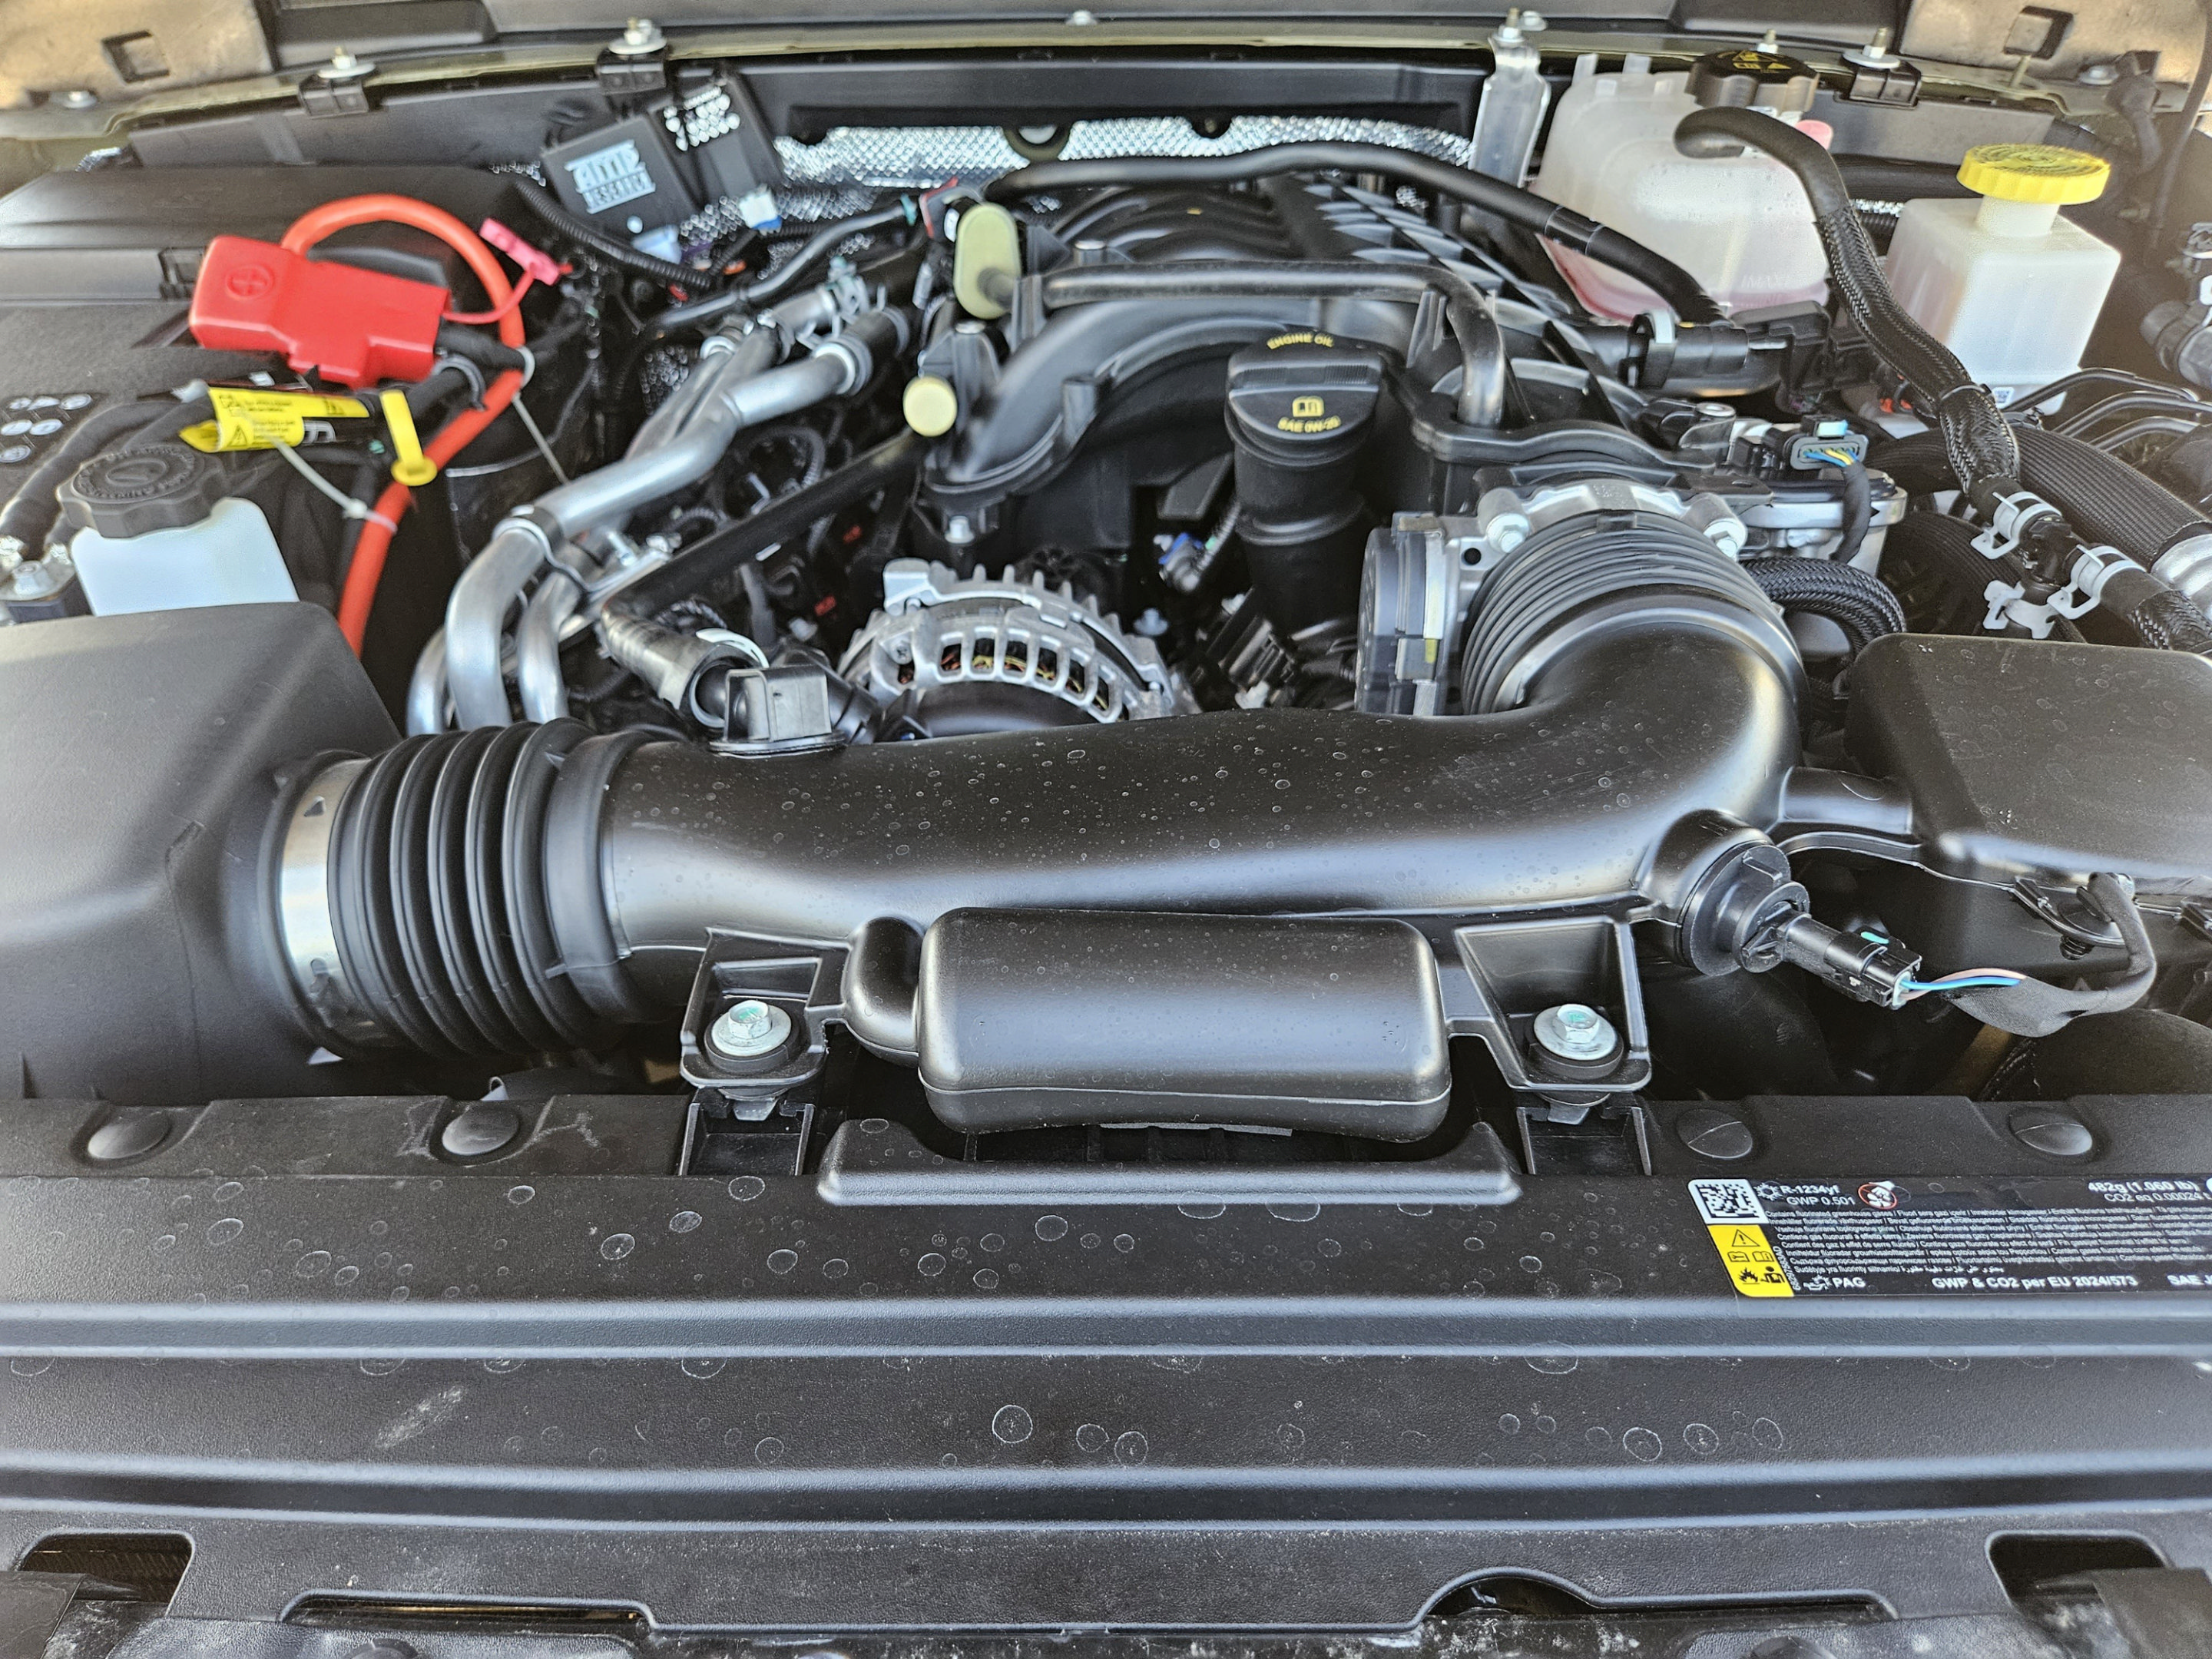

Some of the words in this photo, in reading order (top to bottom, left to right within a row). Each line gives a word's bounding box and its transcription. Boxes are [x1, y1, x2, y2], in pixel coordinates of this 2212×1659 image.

[1267, 332, 1313, 349] ENGINE
[1314, 333, 1335, 348] OIL
[1277, 416, 1304, 433] SAE
[1304, 415, 1341, 433] 0W-20
[1780, 1184, 1840, 1195] R-1234yf
[2088, 1181, 2128, 1194] 482g
[2126, 1181, 2175, 1192] (1.060
[2174, 1181, 2200, 1191] lb)
[1786, 1196, 1819, 1205] GWP
[1822, 1196, 1856, 1205] 0.501
[2104, 1193, 2134, 1202] CO2
[2135, 1194, 2155, 1203] eq
[2153, 1192, 2204, 1201] 0.00024
[1832, 1277, 1866, 1288] PAG
[1932, 1277, 1969, 1289] GWP
[1972, 1277, 1985, 1288] &
[1985, 1277, 2020, 1289] CO2
[2021, 1278, 2047, 1291] per
[2047, 1276, 2071, 1288] EU
[2071, 1275, 2139, 1287] 2024/573
[2167, 1274, 2204, 1286] SAE
